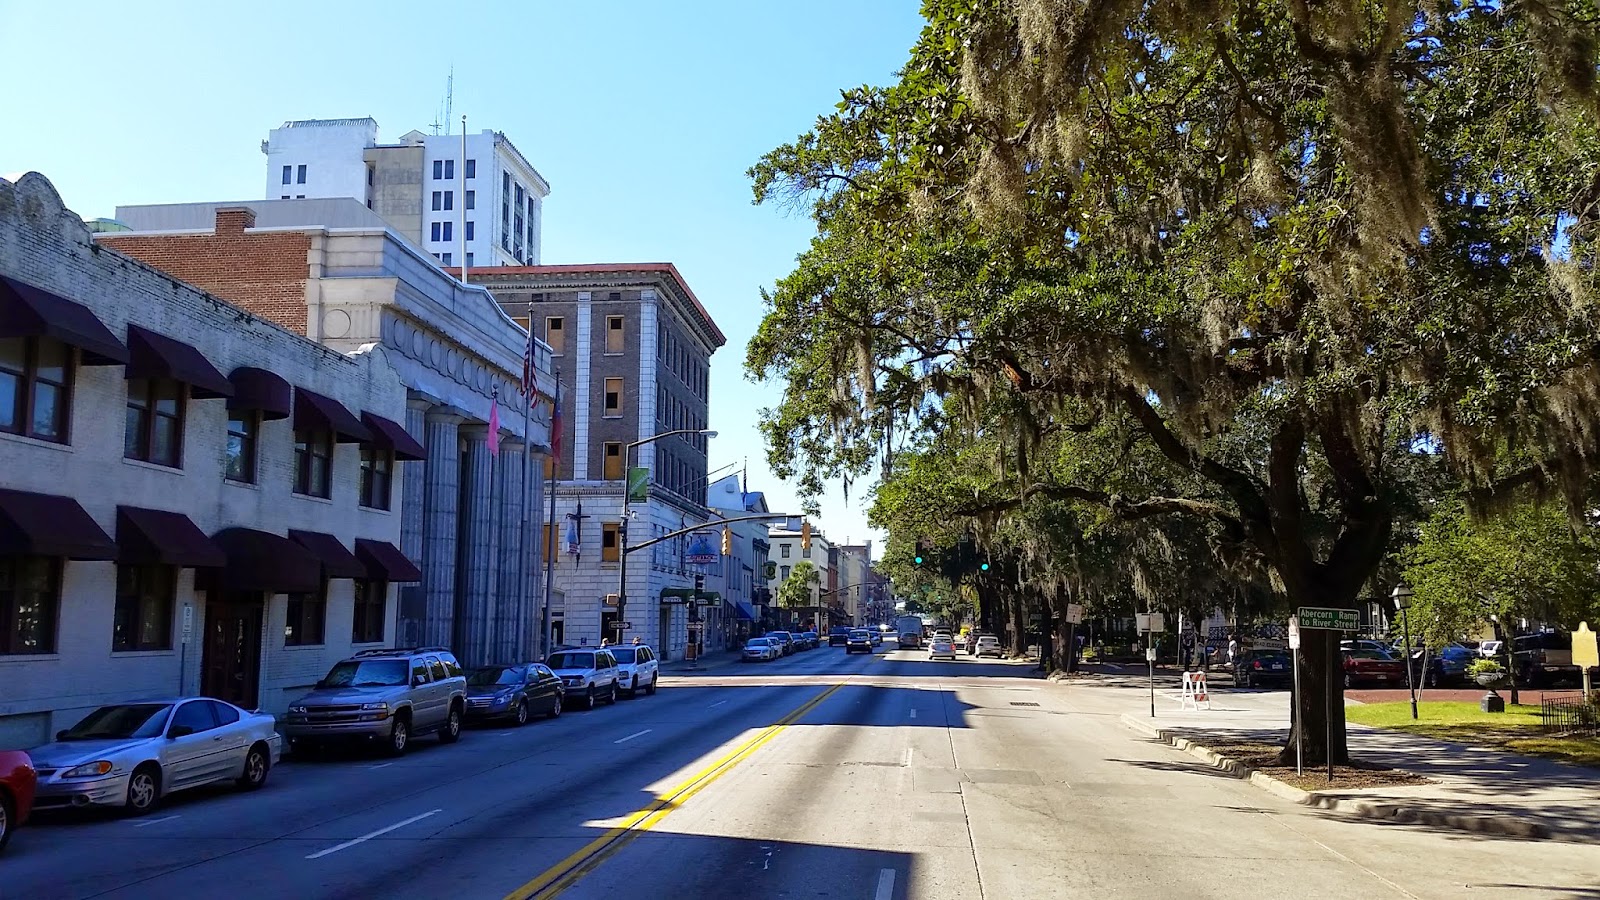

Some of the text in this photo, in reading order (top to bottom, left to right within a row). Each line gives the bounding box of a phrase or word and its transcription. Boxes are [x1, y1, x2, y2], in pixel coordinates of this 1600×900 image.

[1300, 609, 1358, 621] Abercorn Ramp
[1302, 618, 1357, 629] to River Street
